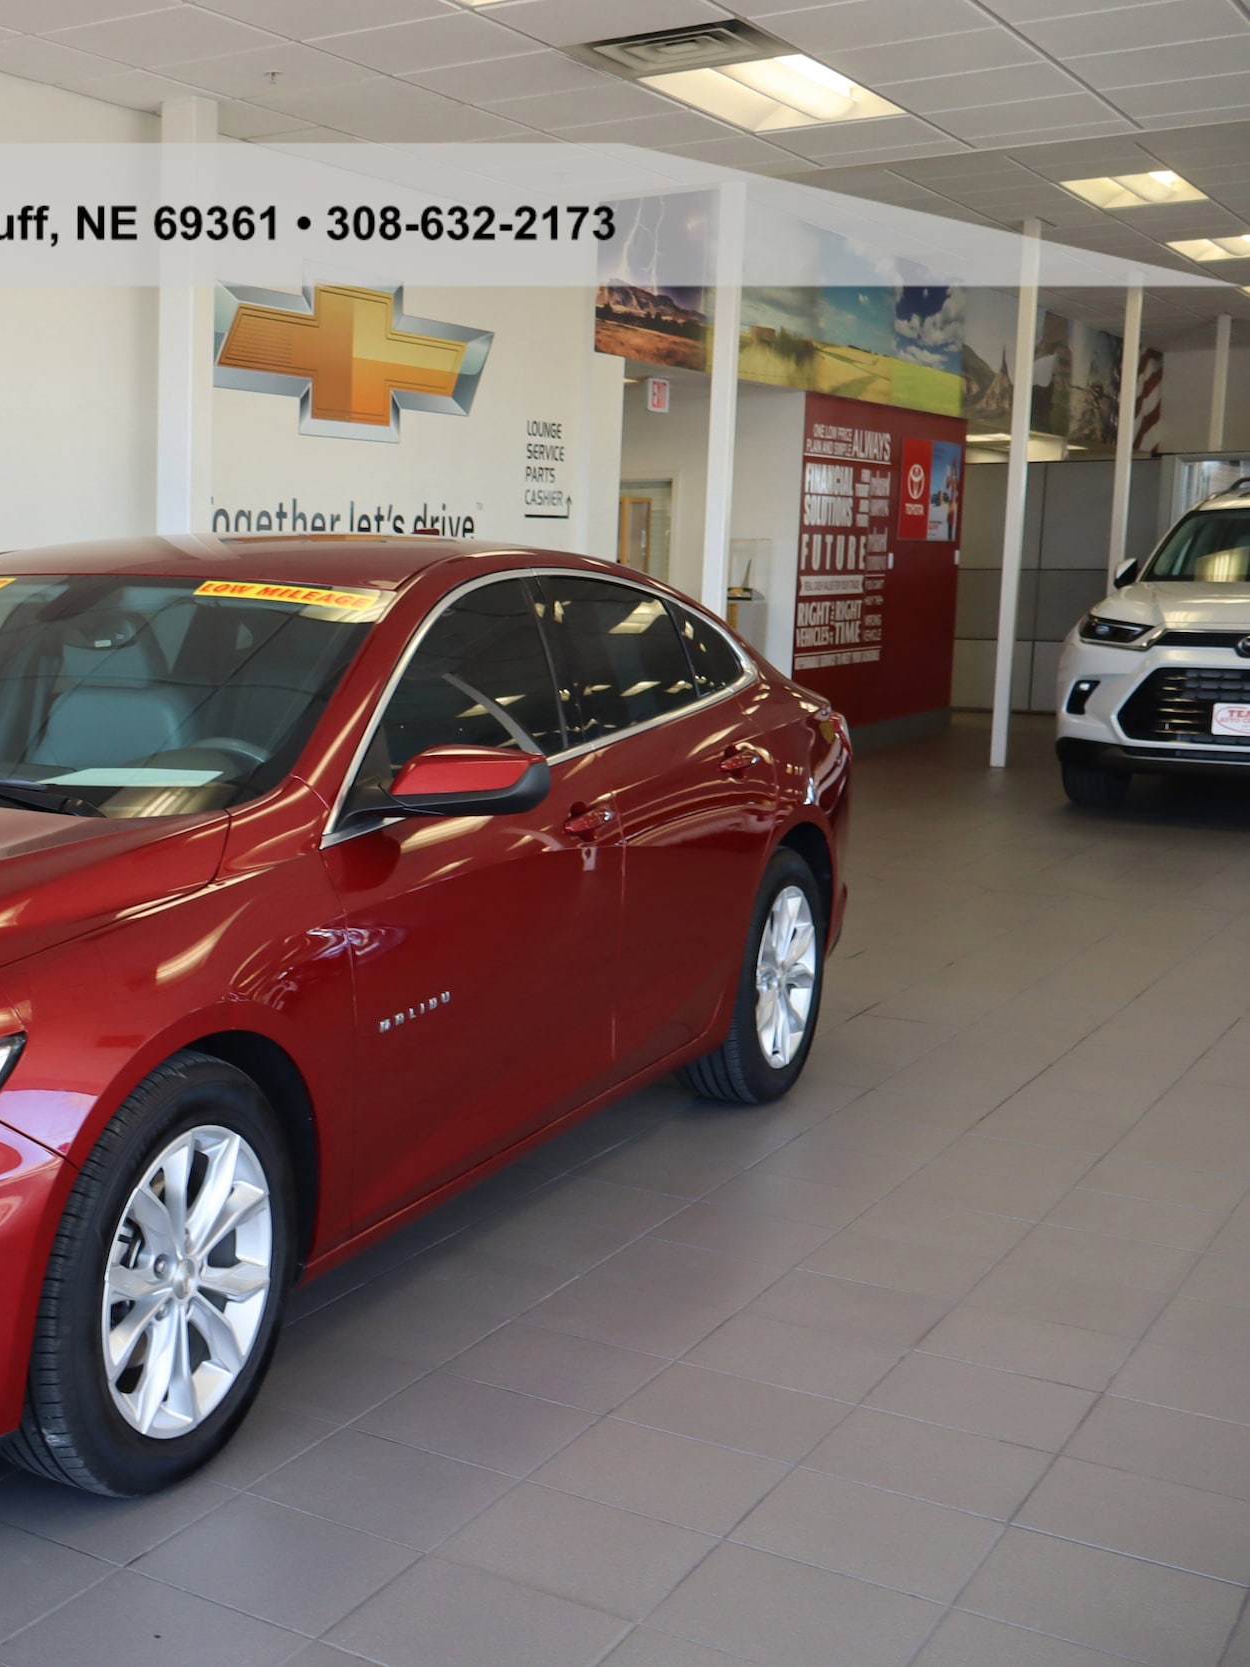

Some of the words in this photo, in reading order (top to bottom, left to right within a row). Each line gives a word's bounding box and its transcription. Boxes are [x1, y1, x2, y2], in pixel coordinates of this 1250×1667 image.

[526, 420, 562, 439] LOUNGE
[526, 443, 565, 462] SERVICE
[852, 429, 891, 461] ALWAYS
[525, 466, 555, 483] PARTS
[524, 489, 564, 506] CASHIER
[800, 534, 866, 571] FUTURE
[200, 582, 254, 594] LOW
[256, 586, 372, 608] MILEAGE
[797, 601, 831, 627] RIGHT
[835, 620, 861, 645] TIME
[379, 990, 451, 1033] MALIBU
